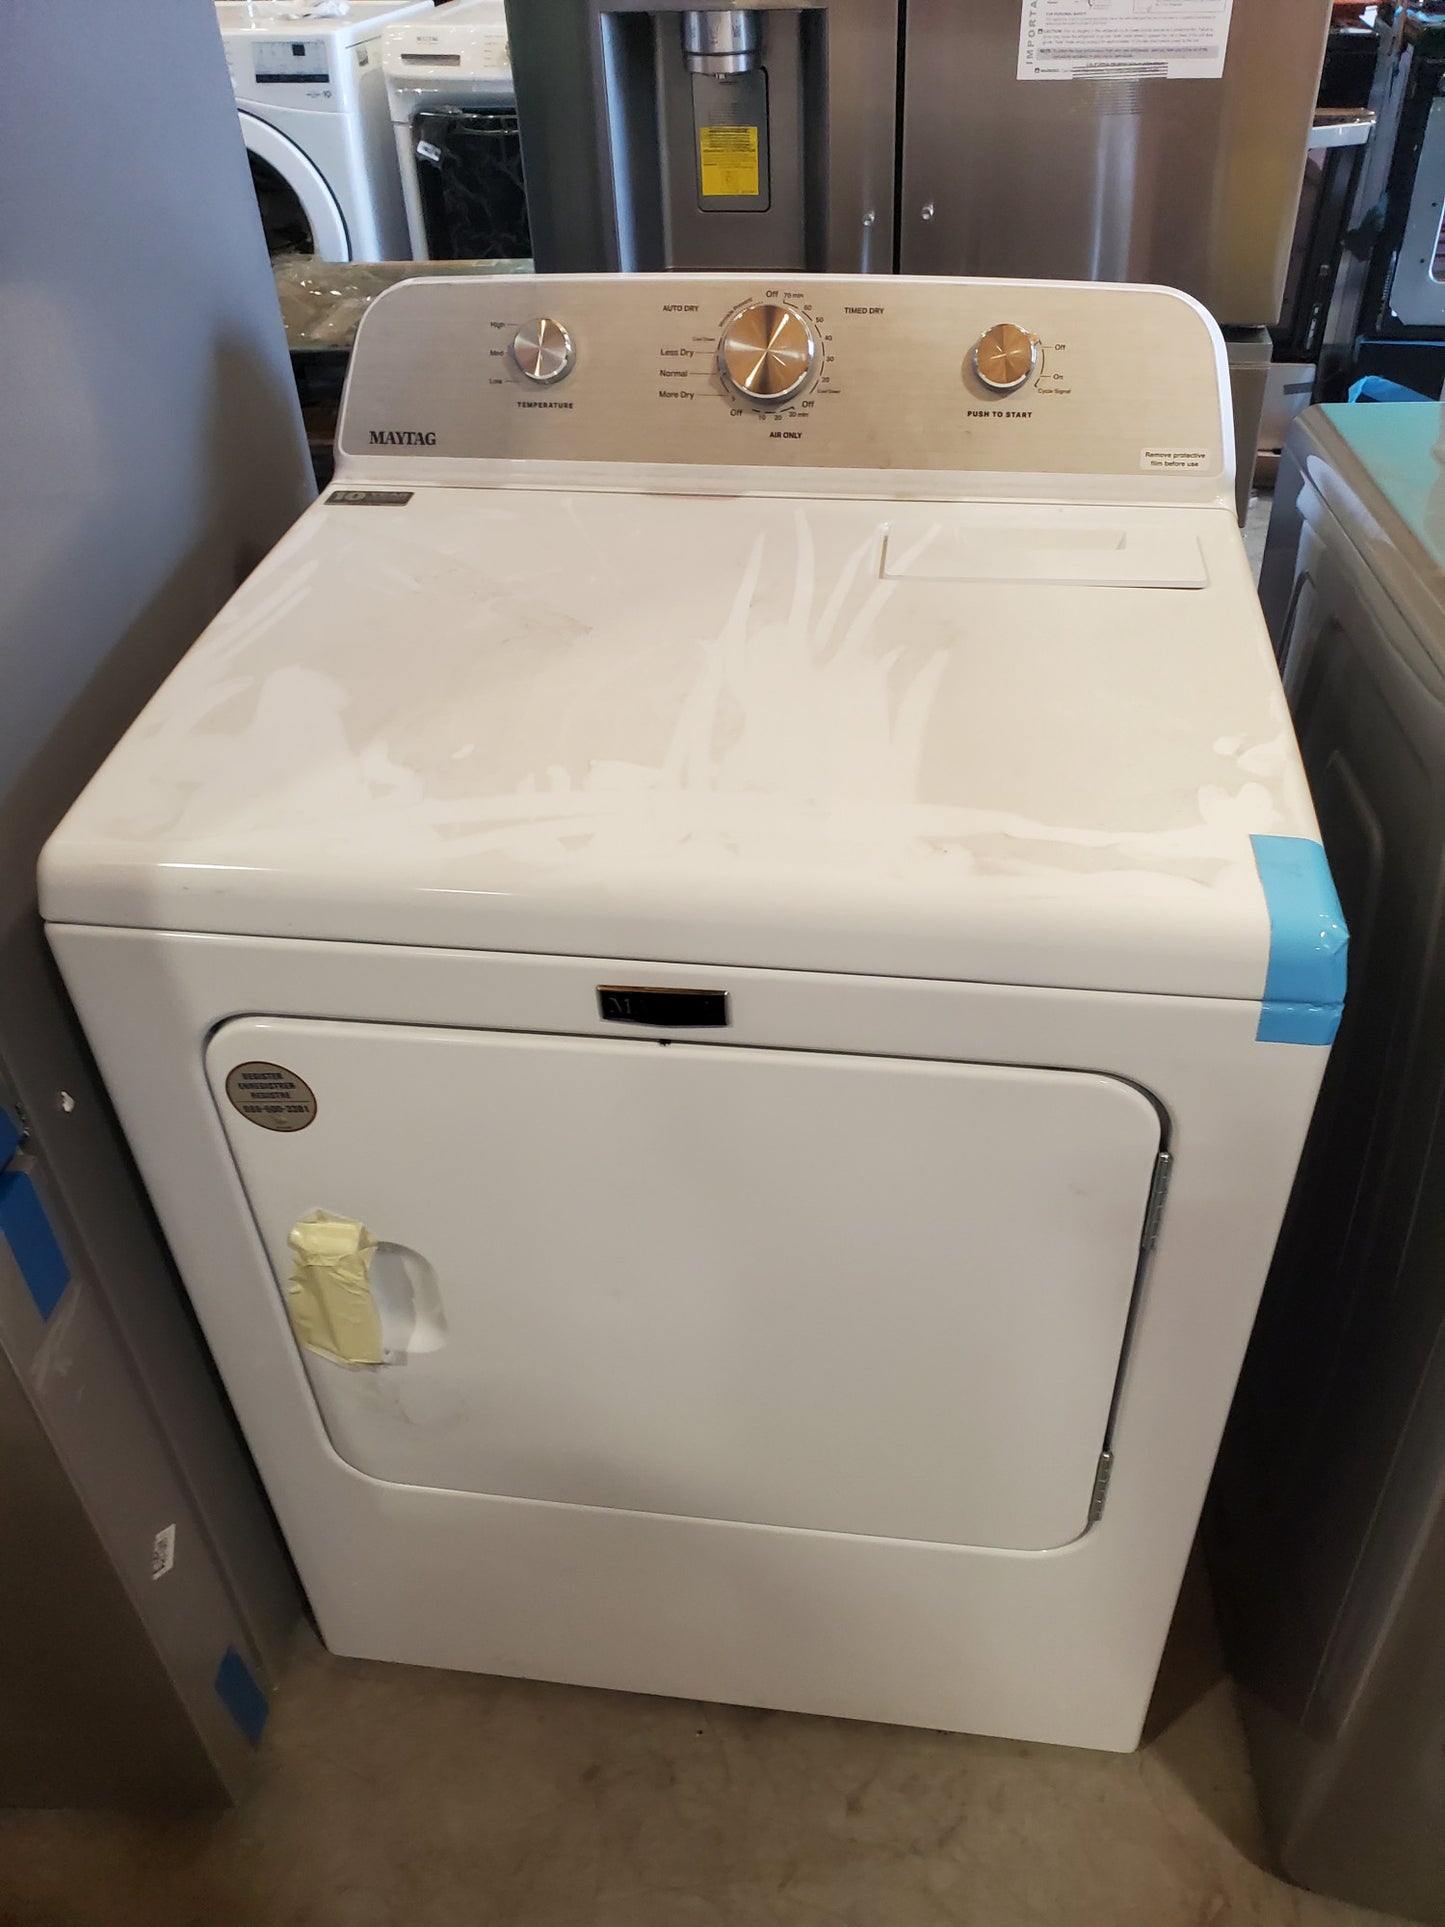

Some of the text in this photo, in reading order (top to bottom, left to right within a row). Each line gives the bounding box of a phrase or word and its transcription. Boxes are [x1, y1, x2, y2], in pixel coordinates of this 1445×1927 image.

[766, 290, 779, 298] Off
[663, 304, 699, 312] AUTO DRY
[844, 306, 884, 315] TIMED DRY
[490, 321, 505, 329] High
[680, 349, 694, 358] Dry
[659, 369, 688, 377] Normal
[680, 391, 695, 400] Dry
[517, 401, 574, 409] TEMPERATURE
[967, 410, 990, 418] PUSH
[369, 430, 437, 446] MAYTAG
